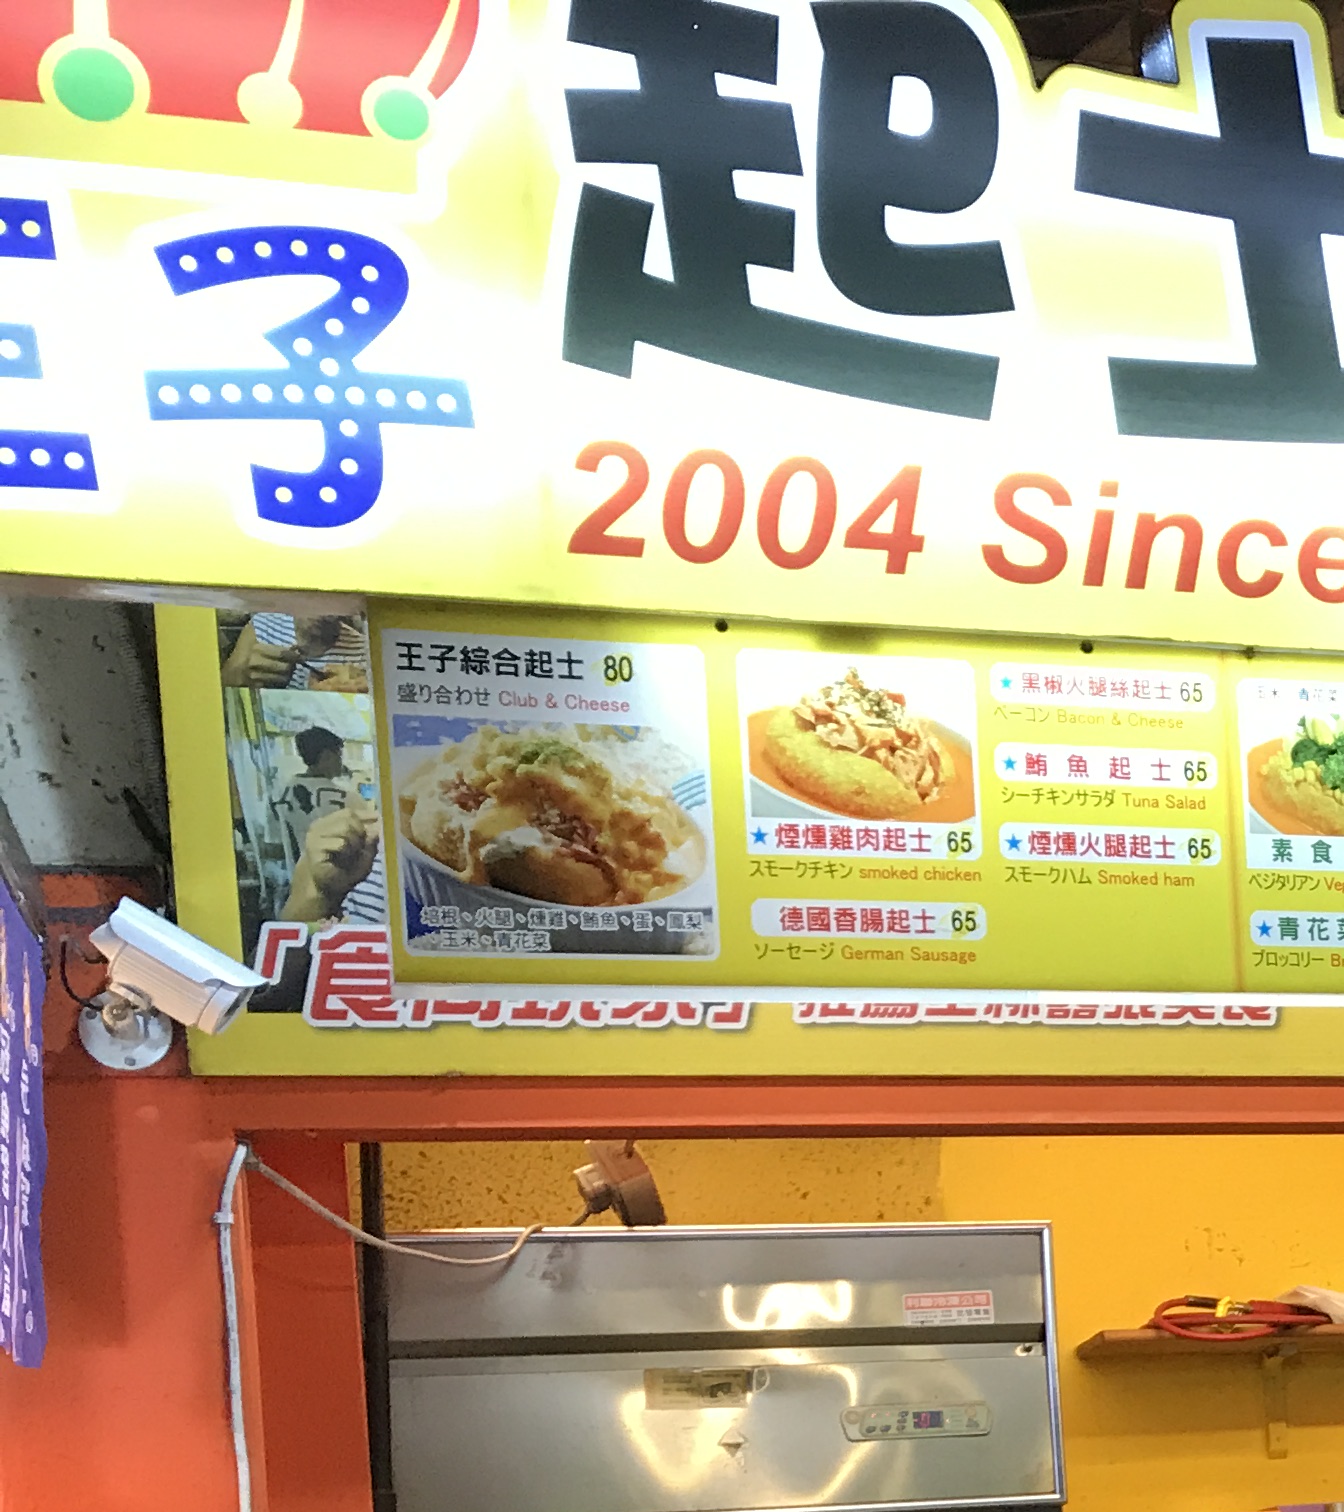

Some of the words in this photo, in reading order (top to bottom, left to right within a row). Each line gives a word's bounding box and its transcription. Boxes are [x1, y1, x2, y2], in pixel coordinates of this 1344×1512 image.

[568, 441, 924, 576] 2004
[396, 641, 584, 681] 王子綜合起士
[603, 654, 633, 682] 80
[397, 683, 490, 708] 盛り合わせ
[498, 690, 538, 708] Club
[545, 693, 559, 708] &
[564, 694, 630, 713] Cheese
[1179, 681, 1203, 704] 65
[1057, 710, 1105, 727] Bacon
[1127, 712, 1184, 730] Cheese
[1024, 752, 1172, 783] 鮪魚起士
[1183, 760, 1208, 784] 65
[1001, 787, 1117, 809] シーチキンサラダ
[1121, 792, 1159, 811] Tuna
[1164, 793, 1207, 811] Salad
[775, 823, 931, 854] 煙燻雞肉起士
[946, 830, 973, 854] 65
[1027, 829, 1176, 860] 煙燻火腿起士
[1187, 837, 1212, 860] 65
[749, 860, 853, 881] スモークチキン
[859, 865, 918, 881] smoked
[923, 865, 982, 883] chicken
[1004, 866, 1093, 886] スモークハム
[1097, 869, 1158, 887] Smoked
[1162, 870, 1196, 887] ham
[1249, 871, 1320, 891] ベジタリアン
[951, 910, 977, 933] 65
[754, 941, 835, 961] ソーセージ
[841, 945, 904, 962] German
[910, 947, 977, 965] Sausage
[1253, 949, 1325, 968] ブロッコリー
